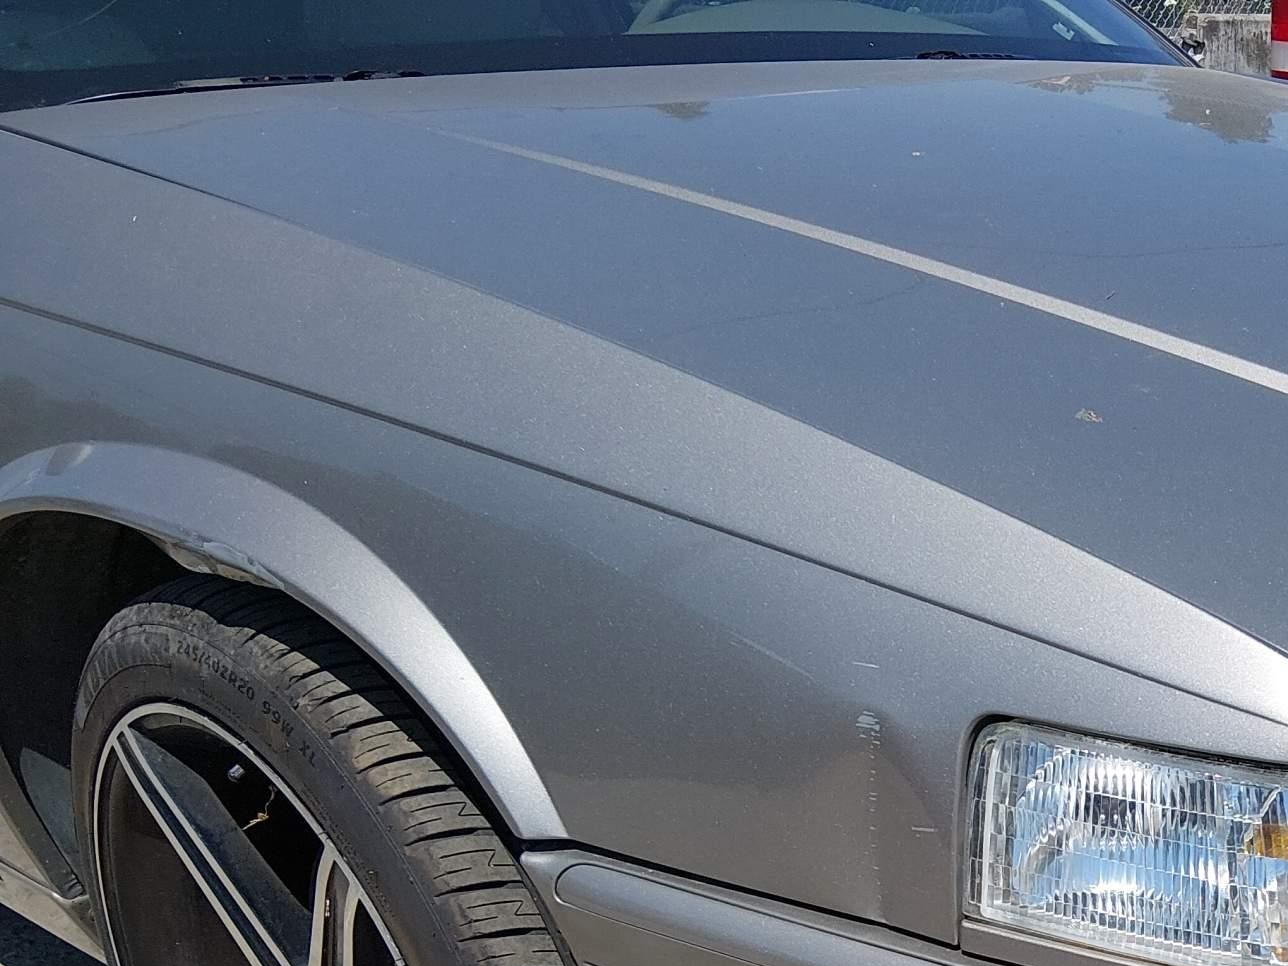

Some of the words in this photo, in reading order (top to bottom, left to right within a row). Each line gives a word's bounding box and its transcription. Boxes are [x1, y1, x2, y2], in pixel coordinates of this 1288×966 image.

[176, 640, 255, 700] 245/40ZR20
[262, 701, 294, 737] 99W
[300, 740, 316, 767] XL
